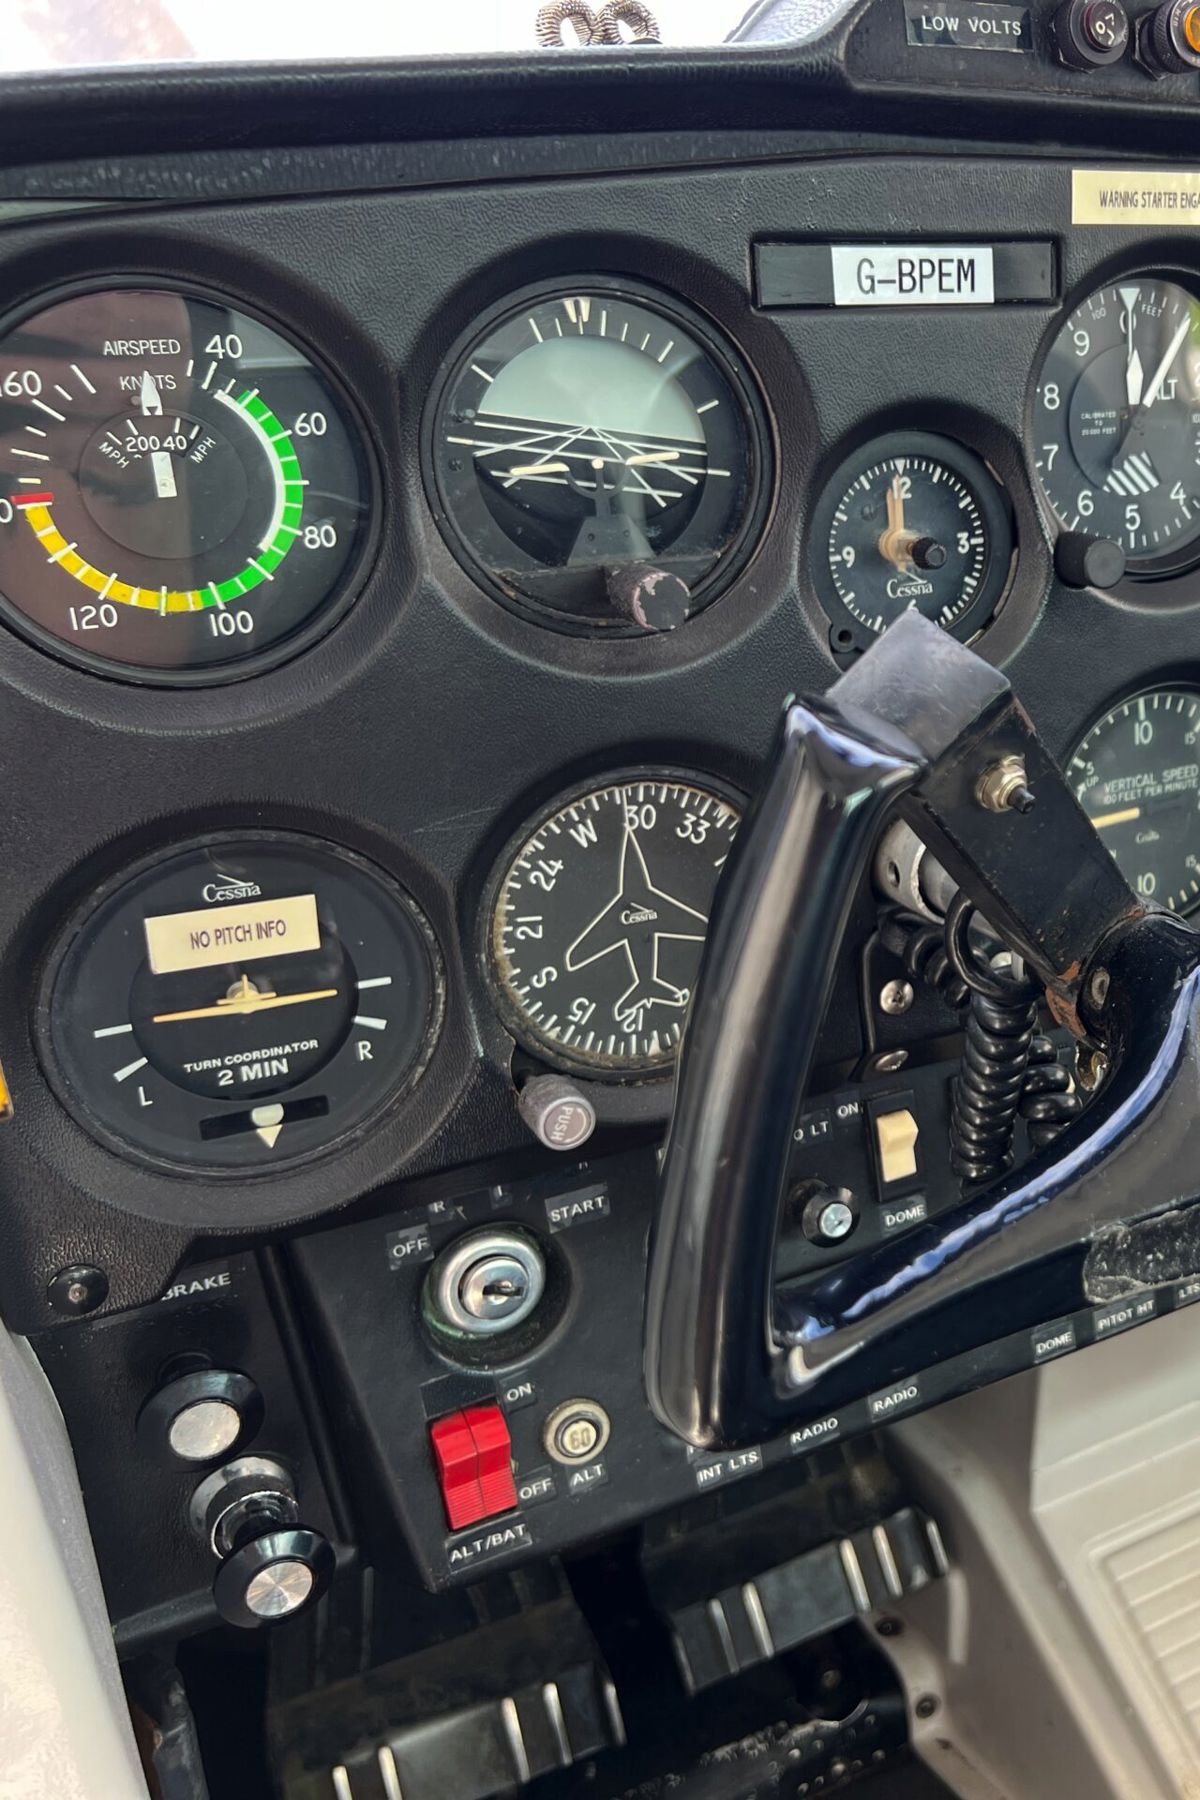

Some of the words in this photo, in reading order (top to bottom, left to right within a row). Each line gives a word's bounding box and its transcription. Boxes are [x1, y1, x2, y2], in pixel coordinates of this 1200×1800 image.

[921, 14, 959, 32] LOW
[967, 18, 1022, 37] VOLTS
[1099, 189, 1139, 209] WARNING
[1141, 191, 1178, 210] STARTER
[856, 257, 976, 294] G-BPEM
[1141, 303, 1163, 319] FEET
[102, 338, 182, 357] AIRSPEED
[204, 333, 244, 360] 40
[1073, 330, 1091, 357] 9
[0, 368, 43, 398] 60
[119, 374, 177, 392] KNTS
[1043, 383, 1060, 410] 8
[294, 412, 328, 436] 60
[125, 436, 160, 453] 200
[163, 434, 188, 451] 40
[189, 436, 217, 465] MPH
[97, 441, 131, 470] MPH
[1042, 444, 1059, 472] 7
[892, 476, 913, 500] 12
[1169, 481, 1187, 506] 4
[1076, 490, 1095, 517] 6
[1124, 504, 1141, 531] 5
[303, 524, 337, 549] 80
[956, 531, 970, 554] 3
[842, 546, 856, 569] 9
[886, 578, 934, 599] Cessna
[68, 603, 118, 631] 120
[208, 610, 254, 637] 100
[1133, 720, 1154, 745] 10
[1184, 732, 1197, 745] 15
[1086, 761, 1095, 776] 5
[1103, 772, 1158, 794] VERTICAL
[1161, 763, 1200, 783] SPEED
[1086, 776, 1100, 788] UP
[1118, 788, 1143, 803] FEET
[1145, 784, 1163, 797] PER
[1164, 777, 1199, 794] MINUTE
[624, 803, 657, 831] 30
[675, 812, 711, 845] 33
[568, 816, 598, 849] W
[1185, 854, 1198, 868] 15
[529, 858, 565, 892] 24
[1136, 872, 1157, 896] 10
[201, 881, 263, 903] Cessna
[515, 914, 543, 941] 21
[620, 908, 659, 926] Cessna
[189, 930, 212, 950] NO
[214, 922, 253, 944] PITCH
[255, 918, 288, 940] INFO
[530, 964, 559, 990] S
[568, 996, 597, 1026] 15
[183, 1057, 222, 1075] TURN
[223, 1037, 320, 1067] COORDINATOR
[357, 1039, 375, 1062] R
[217, 1069, 236, 1087] 2
[240, 1057, 290, 1083] MIN
[137, 1086, 154, 1107] L
[837, 1101, 859, 1119] ON
[550, 1105, 575, 1142] PUSH
[811, 1119, 830, 1136] LT
[434, 1199, 447, 1214] R
[550, 1195, 606, 1223] START
[885, 1203, 926, 1228] DOME
[392, 1236, 429, 1260] OFF
[1100, 1306, 1134, 1332] PITOT
[1136, 1299, 1155, 1316] HT
[1035, 1330, 1073, 1354] DOME
[506, 1381, 533, 1402] ON
[872, 1384, 920, 1414] RADIO
[790, 1416, 839, 1446] RADIO
[571, 1463, 605, 1487] ALT
[698, 1461, 723, 1484] INT
[728, 1449, 761, 1471] LTS
[519, 1477, 553, 1501] OFF
[449, 1522, 527, 1564] ALT/BAT
